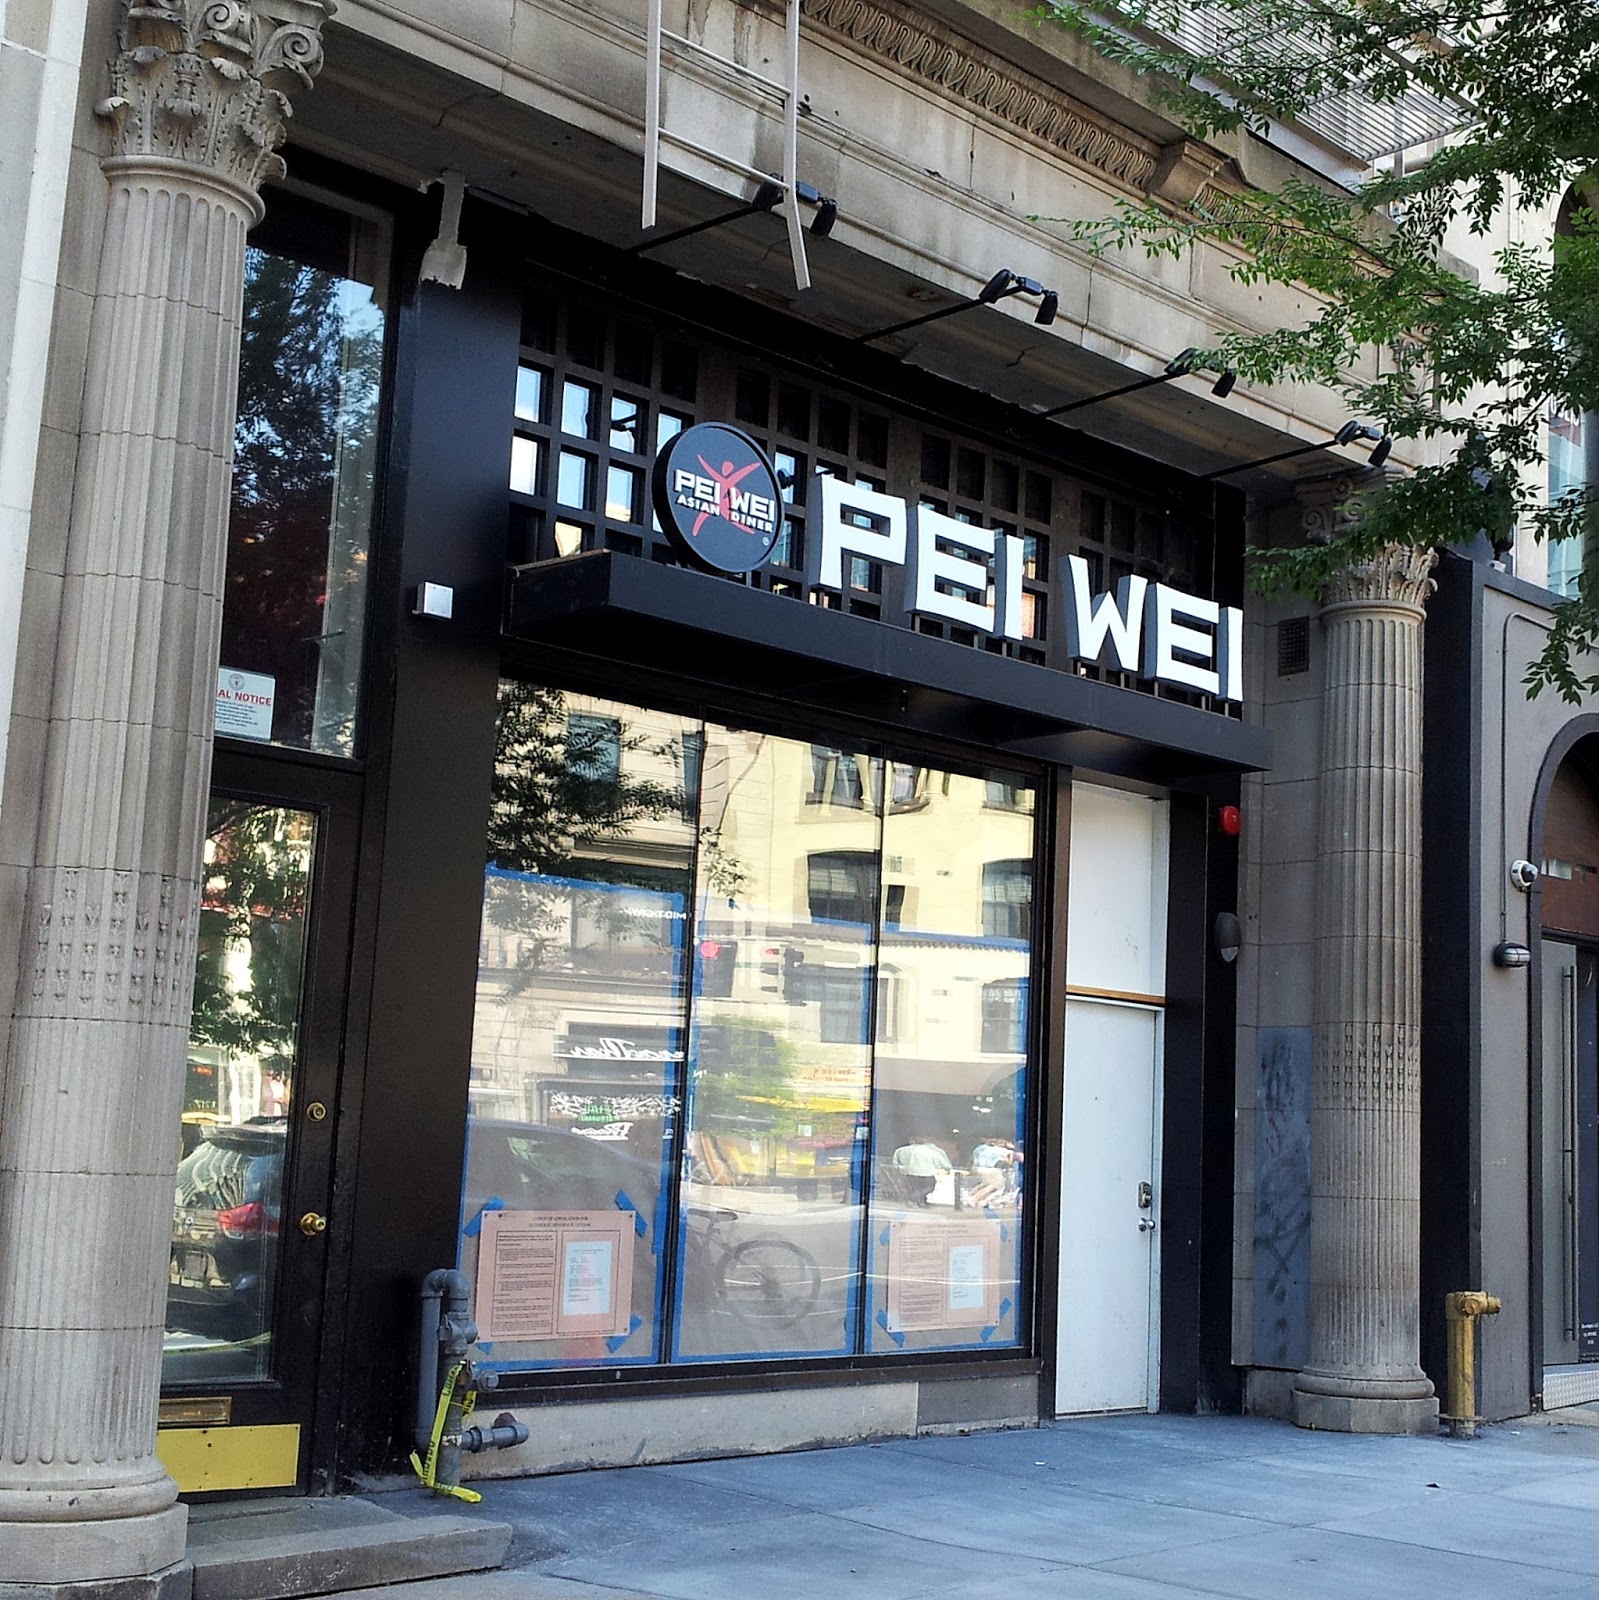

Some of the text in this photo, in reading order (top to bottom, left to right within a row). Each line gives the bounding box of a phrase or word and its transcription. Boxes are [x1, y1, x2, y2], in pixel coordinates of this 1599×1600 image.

[674, 469, 775, 521] PEI WEI
[676, 494, 773, 533] ASIAN DINER
[819, 473, 1244, 702] PEI WEI
[234, 692, 272, 706] NOTICE
